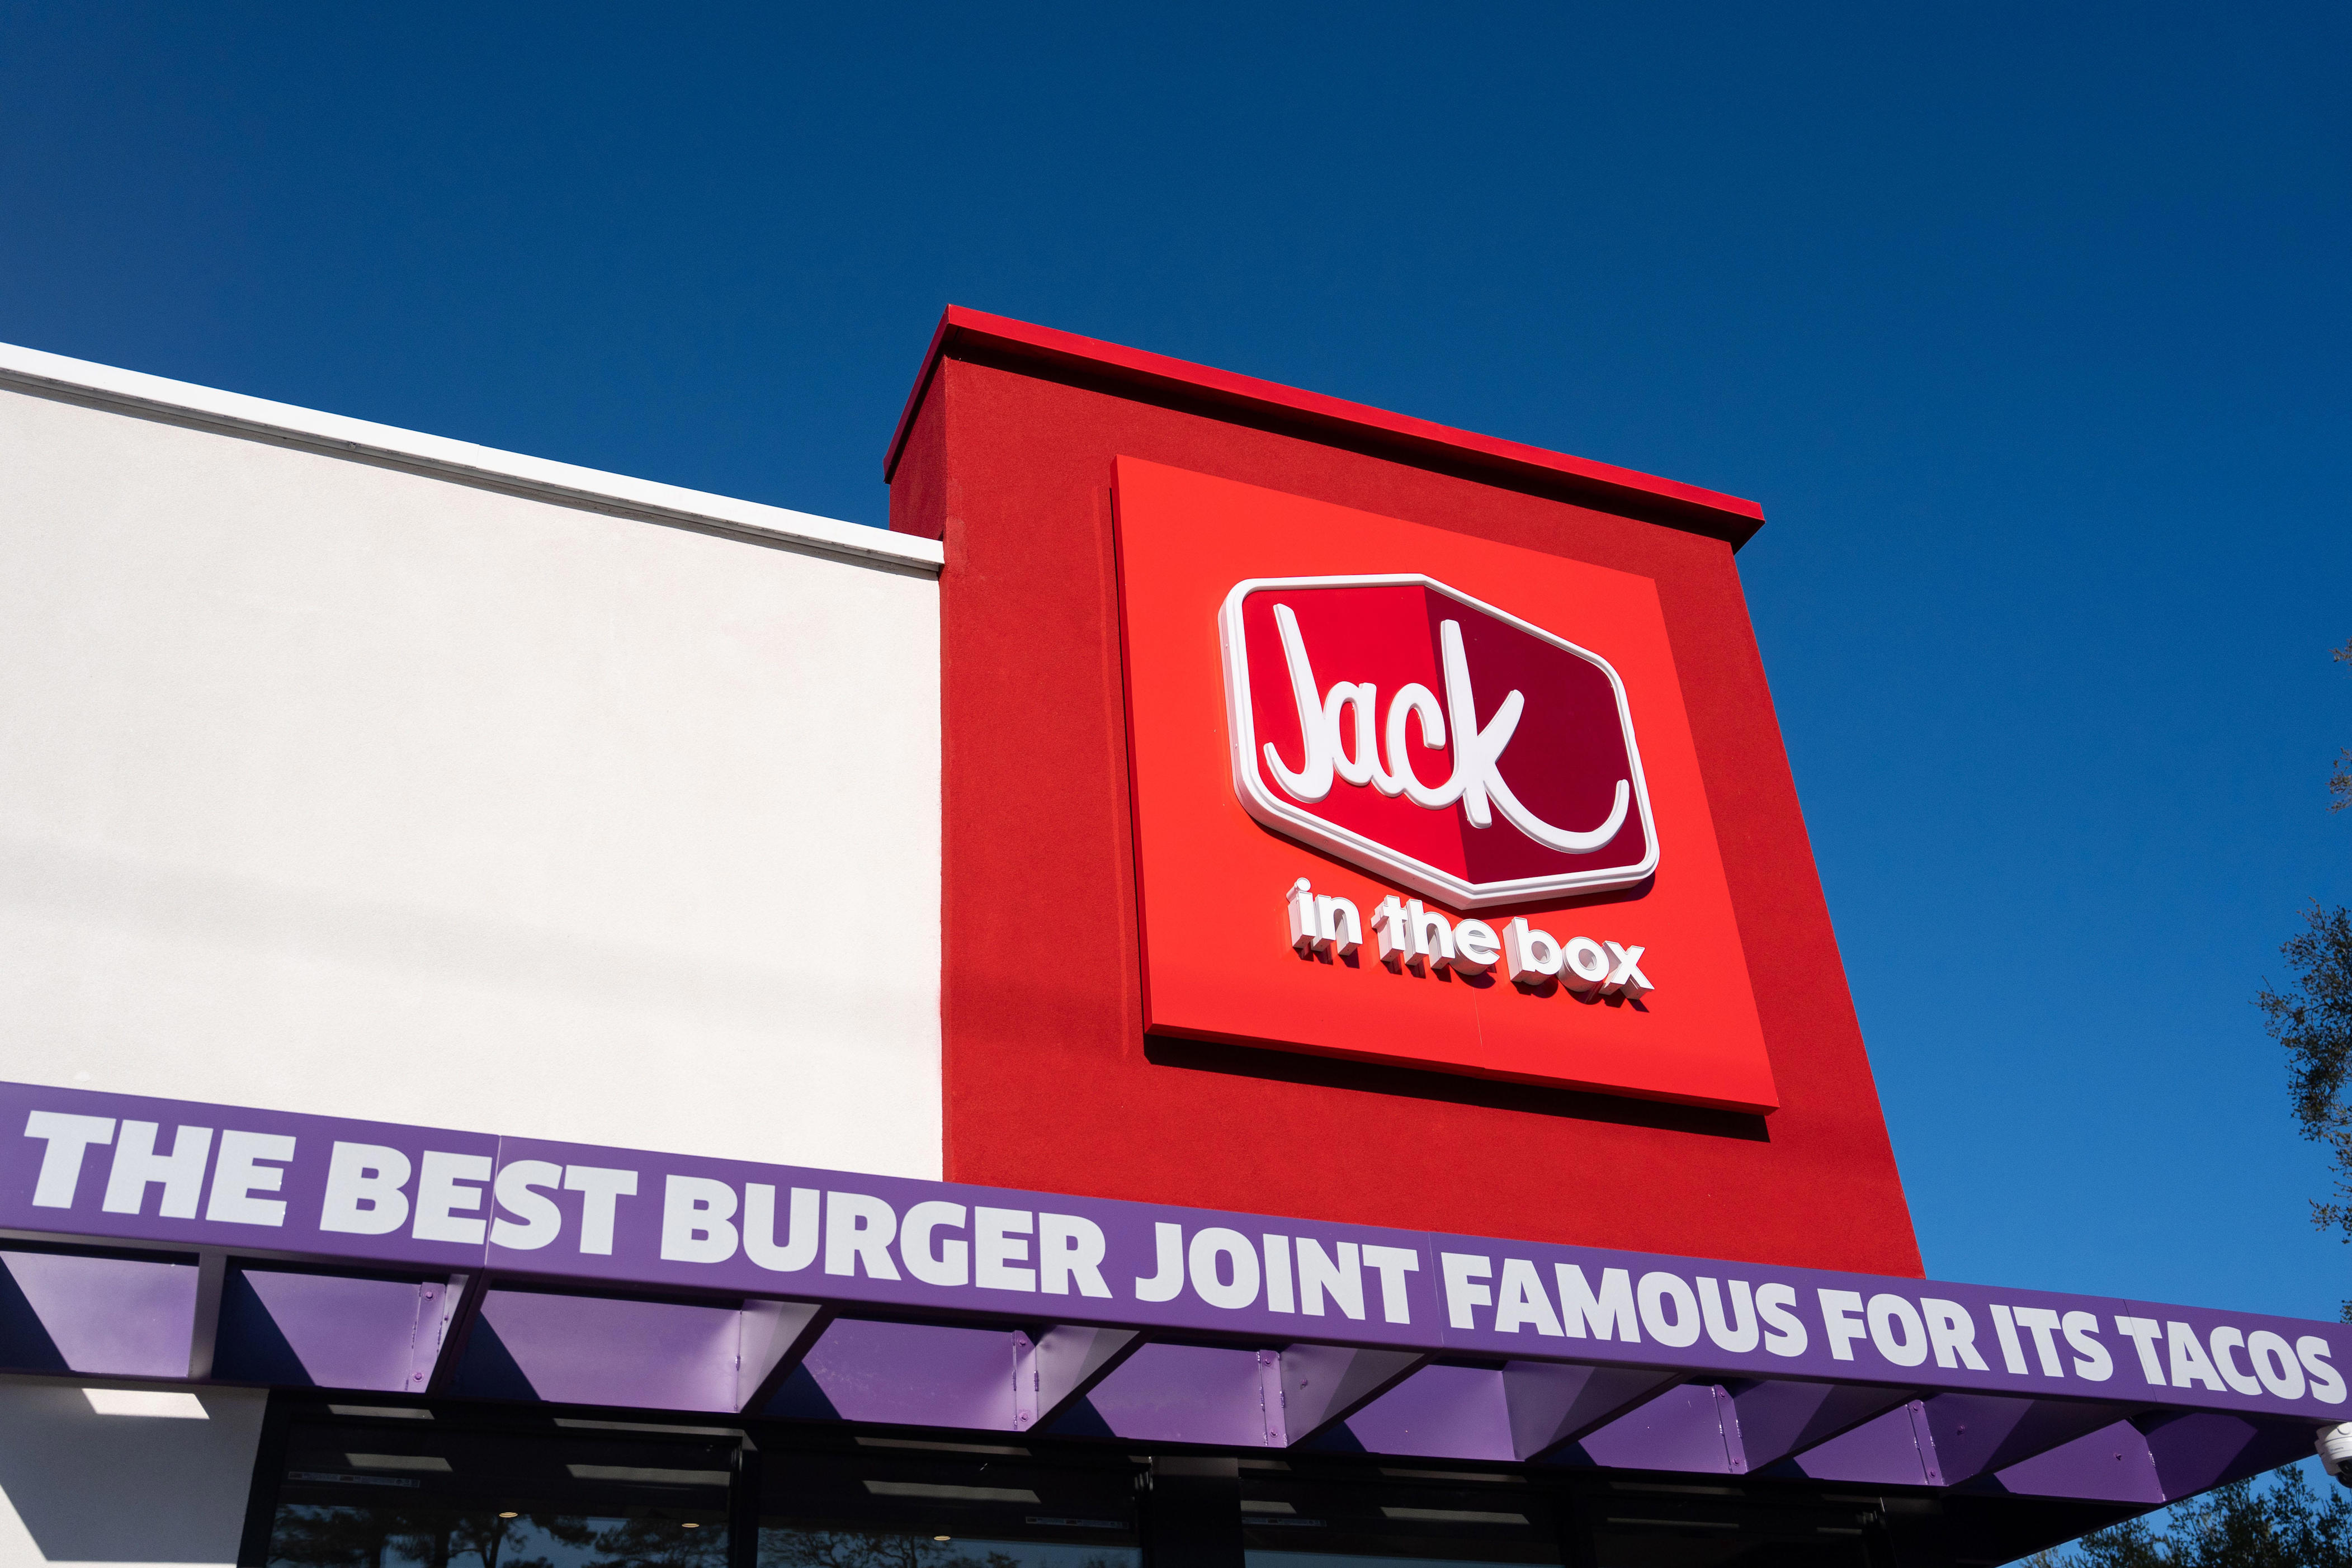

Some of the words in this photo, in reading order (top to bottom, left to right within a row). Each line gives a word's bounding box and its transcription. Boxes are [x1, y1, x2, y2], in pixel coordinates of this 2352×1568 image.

[1263, 602, 1630, 854] Jack
[1287, 877, 1363, 953] in
[1371, 894, 1502, 973] the
[1503, 917, 1655, 998] box
[23, 1110, 296, 1227] THE
[319, 1141, 639, 1256] BEST
[660, 1174, 1113, 1299] BURGER
[1135, 1222, 1420, 1325] JOINT
[1441, 1251, 1808, 1357] FAMOUS
[1817, 1288, 1990, 1372] FOR
[1989, 1304, 2114, 1382] ITS
[2114, 1315, 2348, 1405] TACOS
